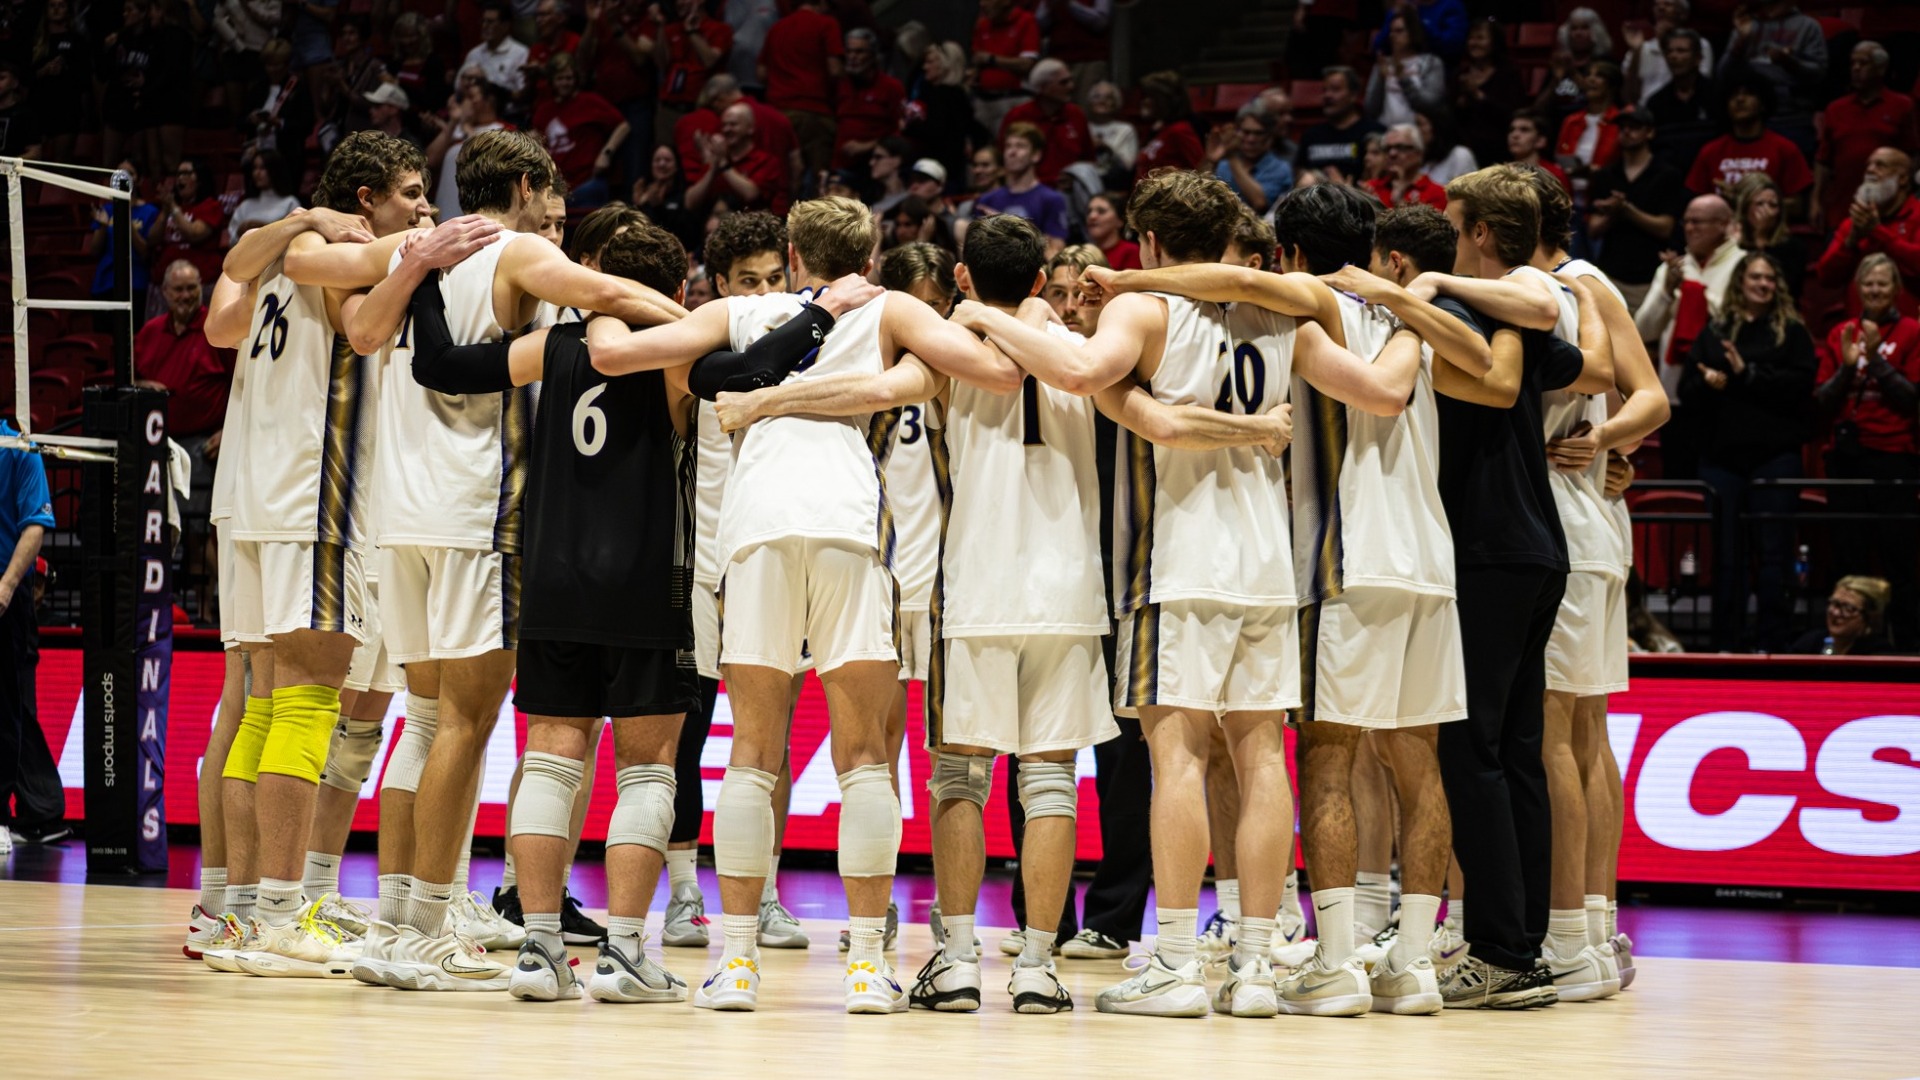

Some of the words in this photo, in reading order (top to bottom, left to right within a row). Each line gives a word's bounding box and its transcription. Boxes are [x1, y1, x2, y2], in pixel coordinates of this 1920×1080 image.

[250, 292, 295, 362] 26
[571, 381, 608, 457] 6
[900, 404, 922, 445] 3
[140, 408, 166, 843] CARDINALS
[101, 671, 116, 723] sports
[102, 725, 117, 788] imports
